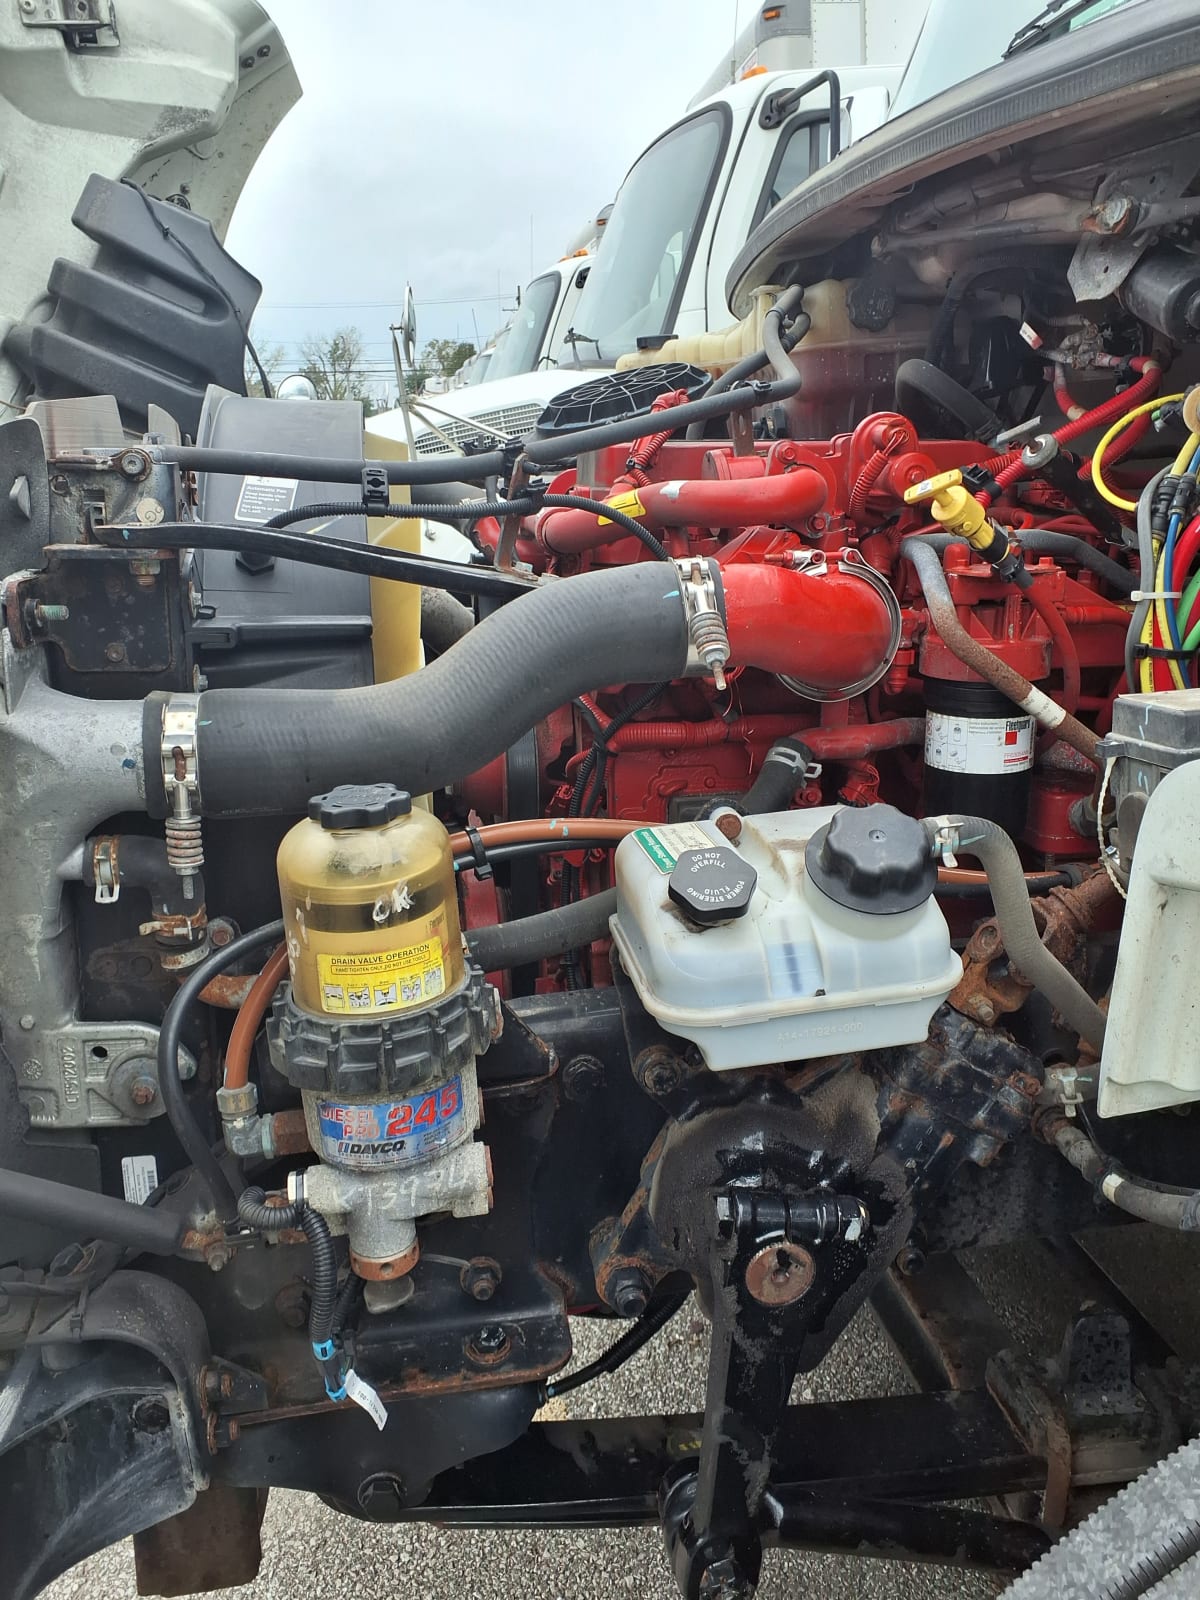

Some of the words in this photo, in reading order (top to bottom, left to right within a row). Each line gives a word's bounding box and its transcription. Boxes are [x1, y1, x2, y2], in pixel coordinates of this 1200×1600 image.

[691, 853, 703, 862] DO
[704, 852, 721, 860] NOT
[690, 859, 727, 873] OVERFILL
[686, 886, 725, 903] STEERING
[703, 884, 731, 896] FLUID
[725, 879, 745, 900] POWER
[357, 955, 383, 964] VALVE
[385, 944, 430, 960] OPERATION
[386, 1084, 457, 1136] 245
[343, 1122, 379, 1138] PRO
